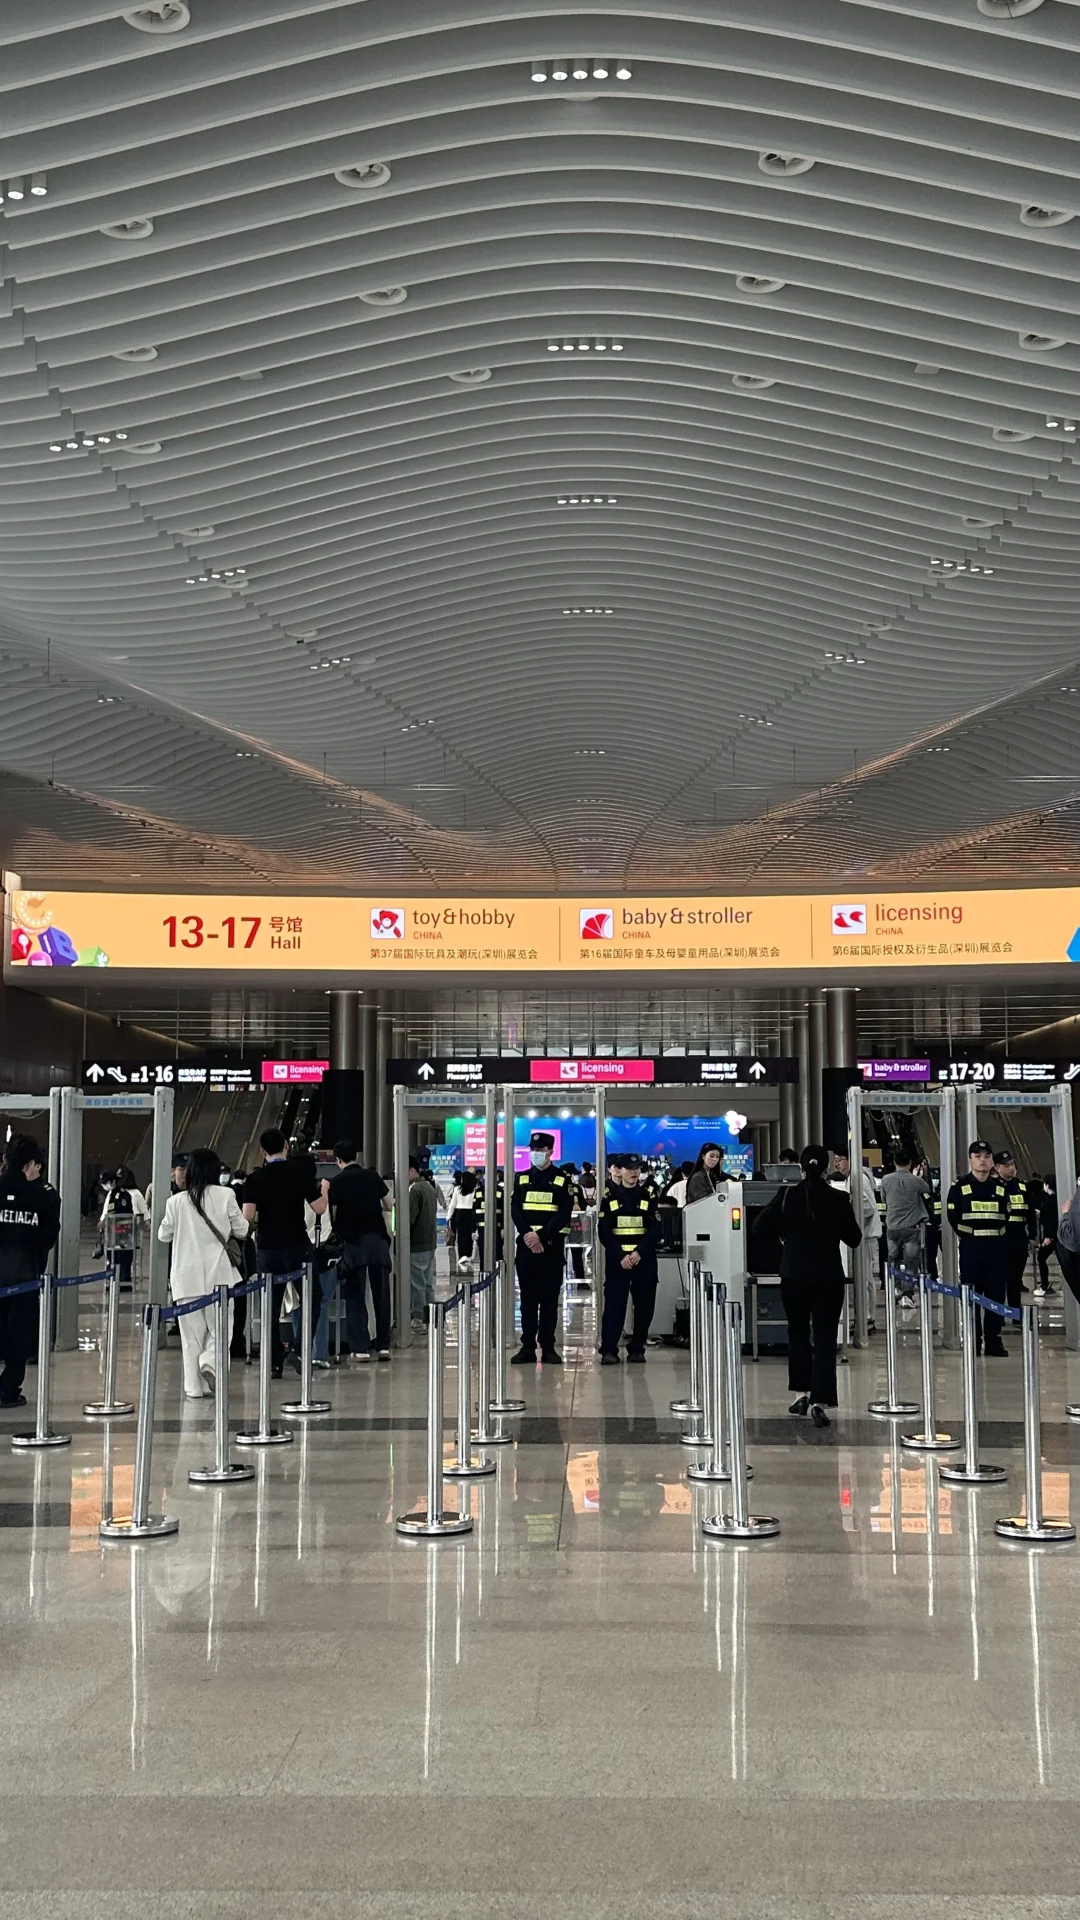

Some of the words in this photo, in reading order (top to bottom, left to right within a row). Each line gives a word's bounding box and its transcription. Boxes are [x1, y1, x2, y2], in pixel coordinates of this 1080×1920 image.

[622, 908, 667, 928] baby
[687, 907, 754, 924] stroller
[875, 902, 963, 924] licensing
[162, 915, 262, 949] 13-17
[268, 916, 303, 934] 号馆
[875, 927, 903, 936] CHINA
[413, 931, 443, 940] CHINA
[622, 931, 651, 939] CHINA
[270, 936, 301, 950] Hall
[140, 1065, 174, 1083] 1-16
[289, 1065, 325, 1076] licensing
[581, 1062, 624, 1075] licensing
[874, 1063, 893, 1073] baby
[900, 1063, 928, 1072] stroller
[949, 1062, 995, 1081] 17-20
